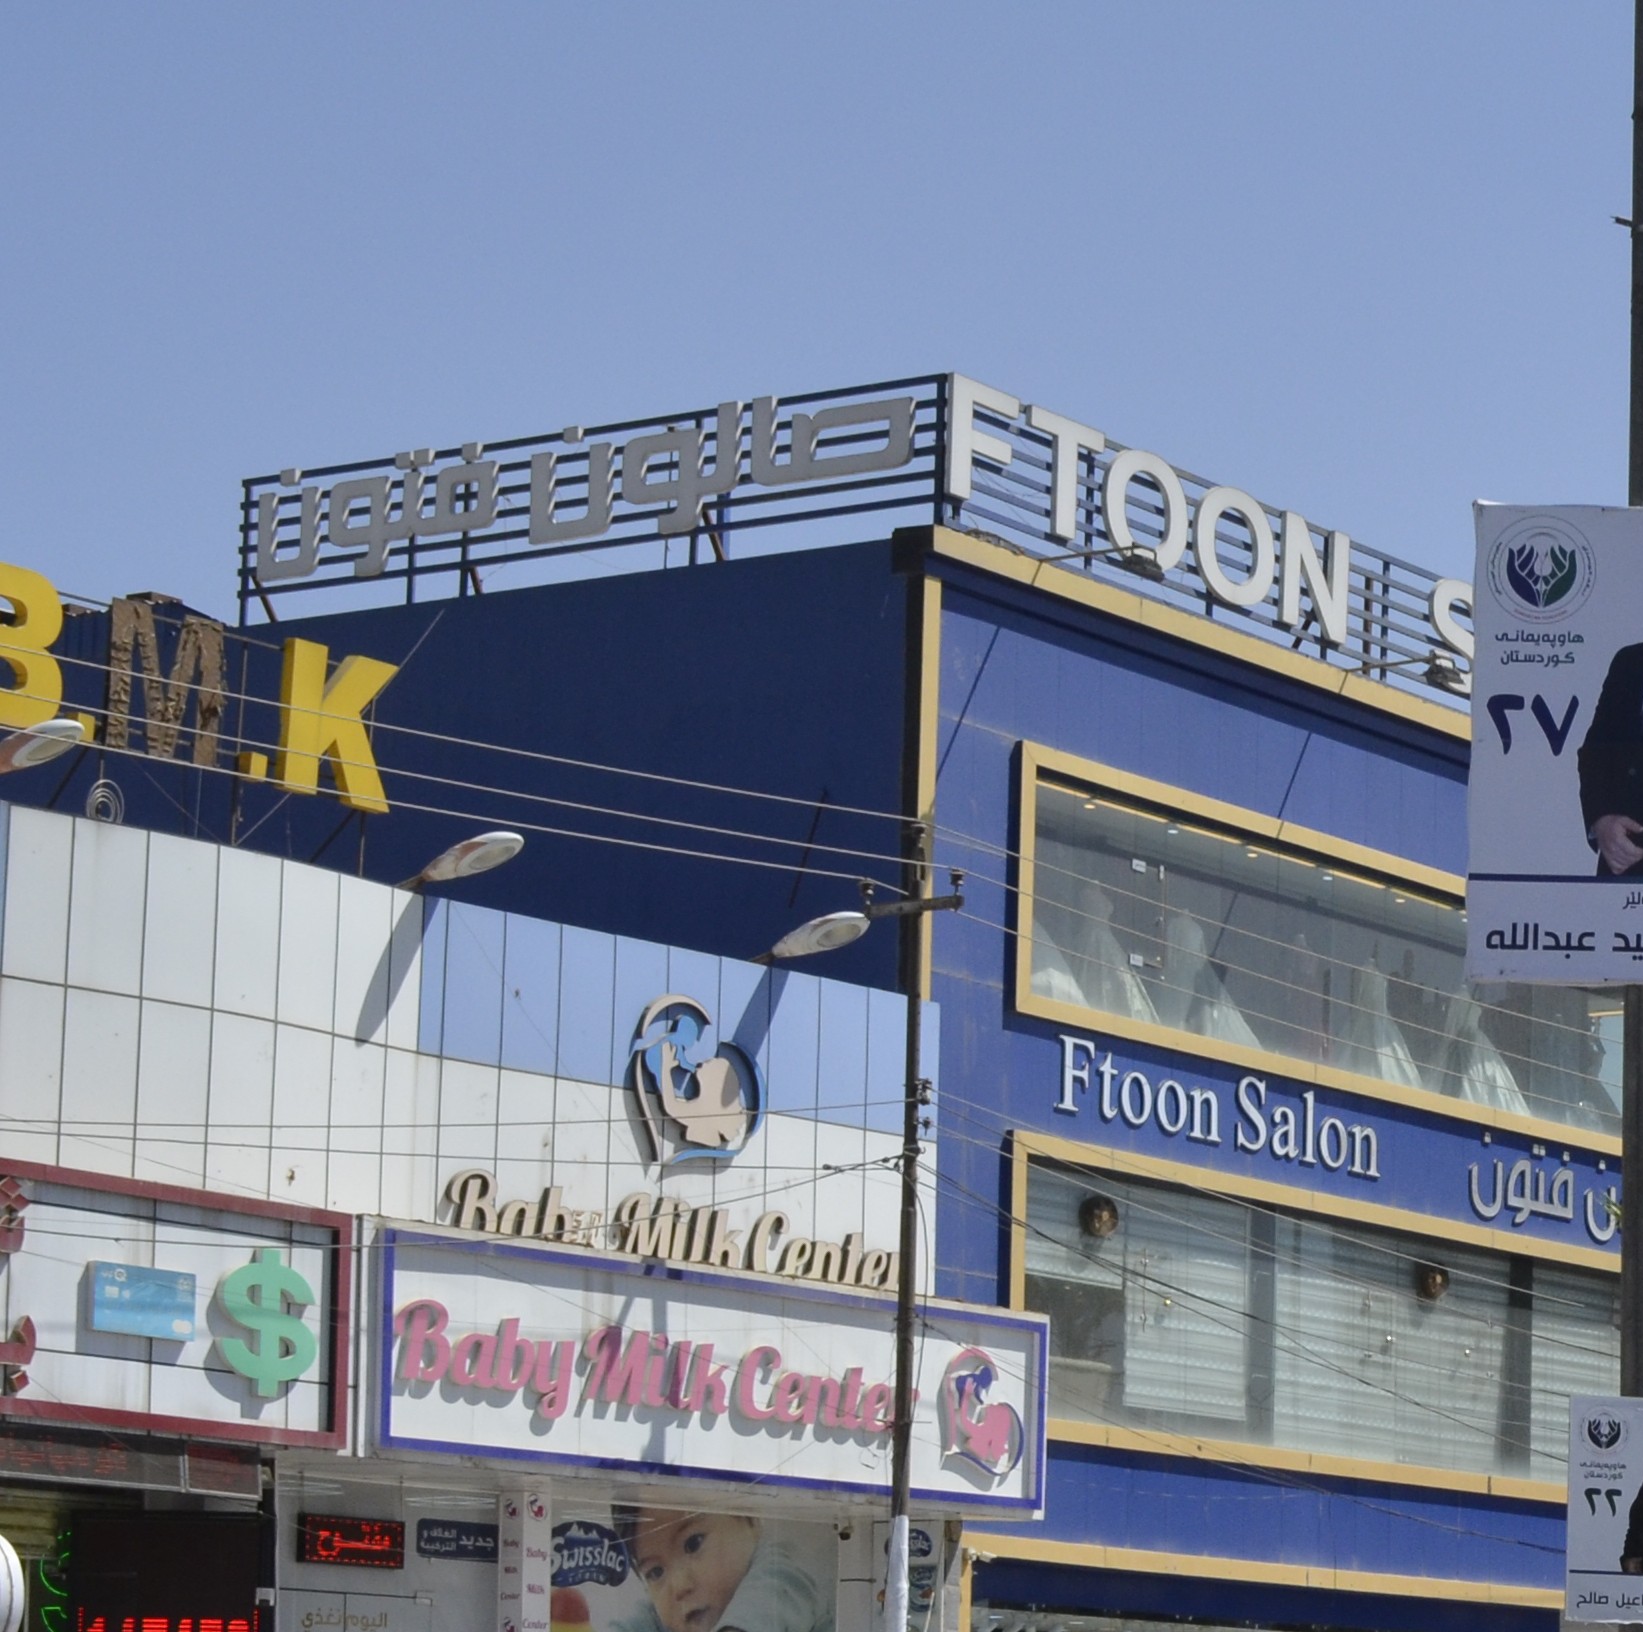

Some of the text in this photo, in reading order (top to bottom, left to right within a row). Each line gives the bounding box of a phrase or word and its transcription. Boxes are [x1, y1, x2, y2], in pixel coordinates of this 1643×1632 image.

[257, 395, 916, 583] صالون فتون
[944, 371, 1352, 646] FTOON
[1486, 693, 1580, 757] ٢٧
[1485, 922, 1596, 960] عبدالله
[1053, 1033, 1380, 1180] Ftoon Salon
[1468, 1131, 1575, 1226] فتون
[612, 1191, 744, 1270] Milk
[393, 1298, 576, 1421] Baby
[584, 1324, 729, 1416] Milk
[1584, 1487, 1622, 1518] ٢٢
